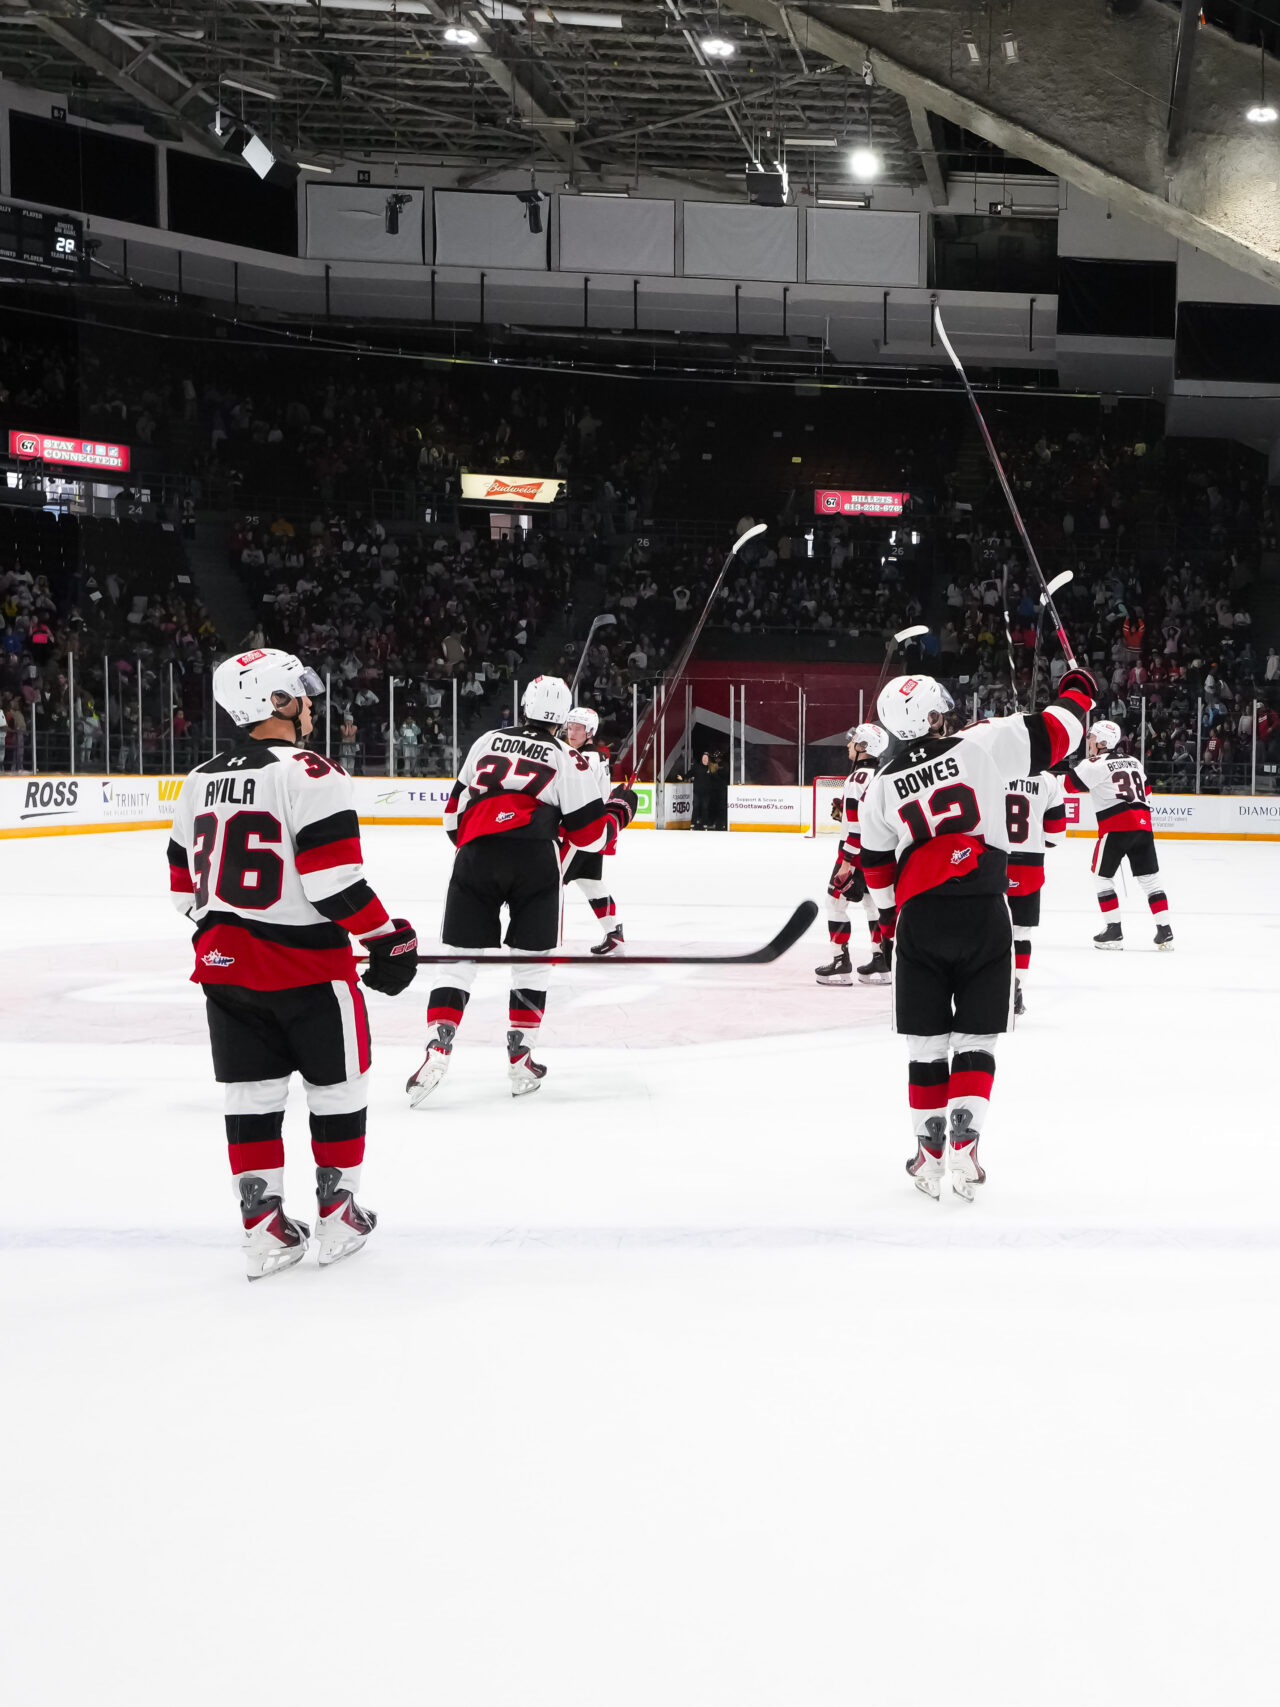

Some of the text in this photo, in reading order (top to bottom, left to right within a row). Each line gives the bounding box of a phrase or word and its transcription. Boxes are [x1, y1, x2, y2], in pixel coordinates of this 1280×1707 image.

[55, 237, 75, 253] 28
[21, 440, 35, 451] 67
[43, 438, 75, 451] STAY
[44, 449, 122, 467] CONNECTED!
[485, 482, 543, 495] Budweiser
[825, 497, 837, 507] 67
[851, 495, 893, 504] BILLETS
[128, 505, 143, 515] 24
[637, 538, 649, 547] 26
[543, 711, 555, 721] 37
[491, 737, 553, 763] COOMBE
[468, 754, 557, 801] 37
[849, 771, 868, 785] 10
[894, 757, 960, 801] BOWES
[204, 777, 256, 807] AVILA
[1004, 779, 1040, 796] WTON
[1111, 770, 1146, 803] 38
[24, 781, 79, 809] ROSS
[116, 793, 150, 807] TRINITY
[898, 782, 981, 845] 12
[193, 810, 284, 910] 36
